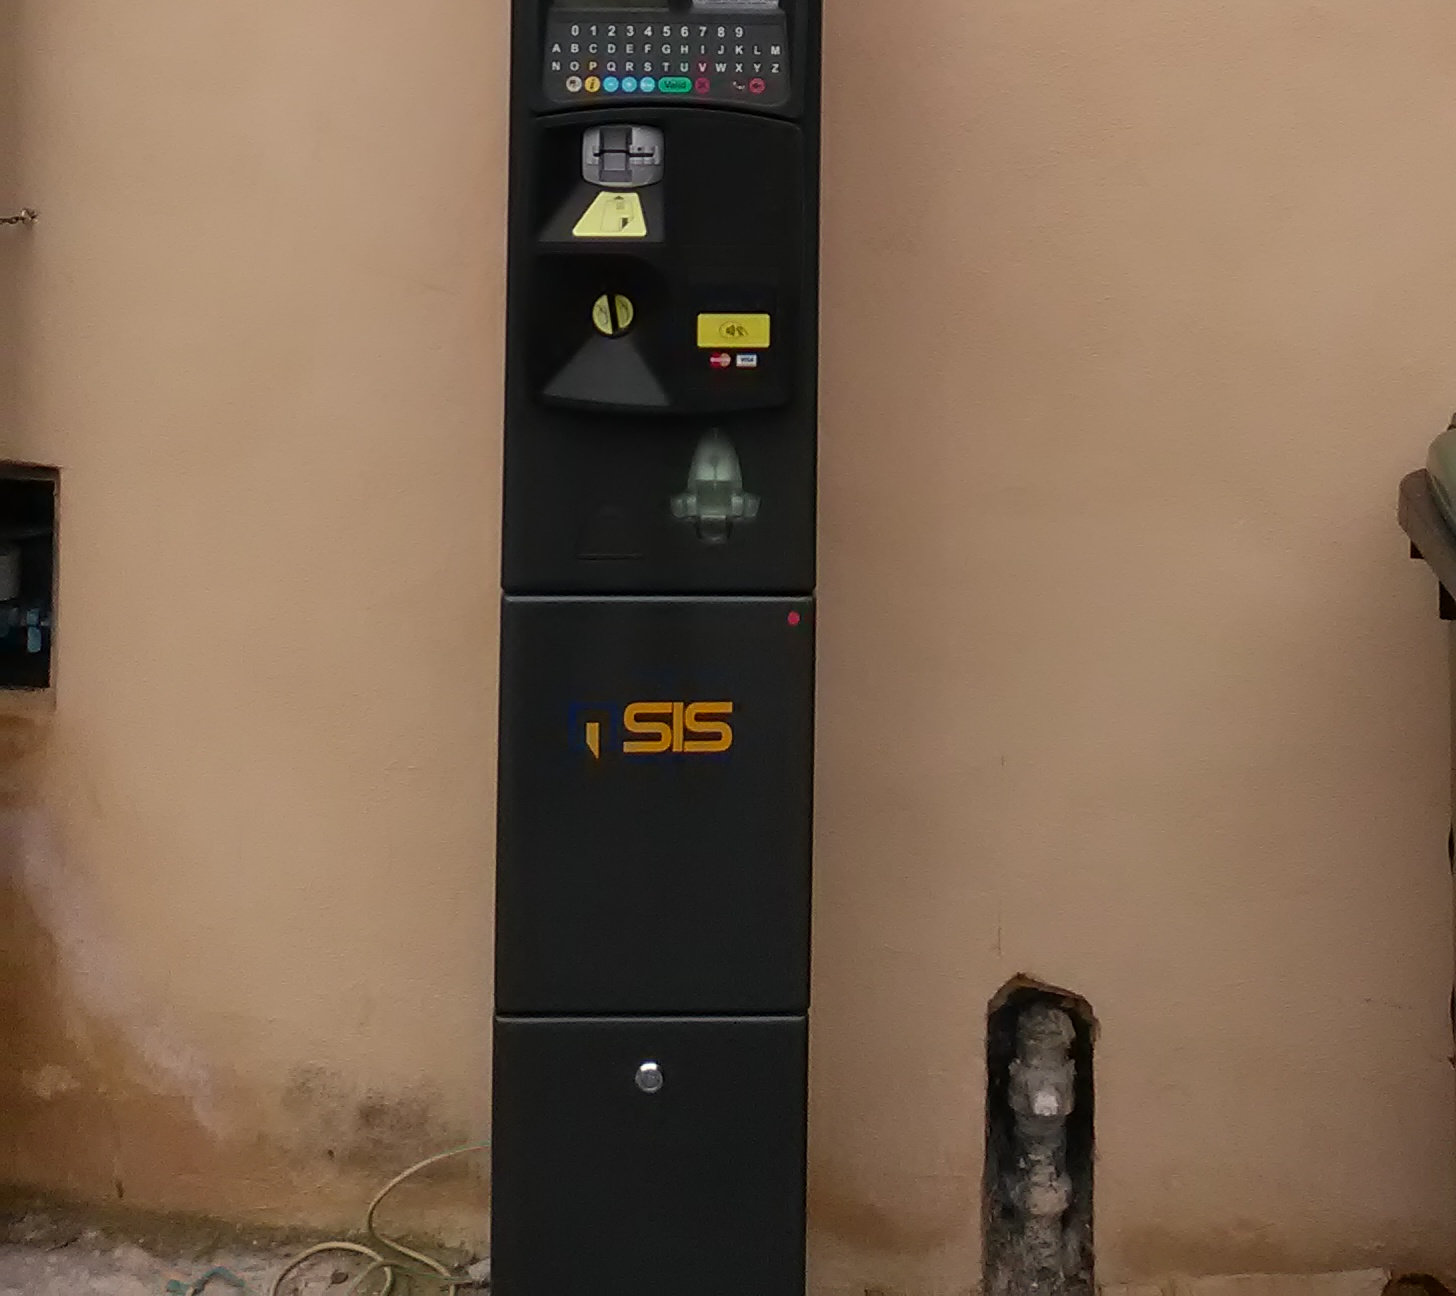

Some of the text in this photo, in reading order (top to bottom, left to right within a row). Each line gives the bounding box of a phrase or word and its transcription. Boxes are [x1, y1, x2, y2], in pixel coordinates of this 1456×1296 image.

[571, 25, 743, 38] 0 1 2 3 4 5 6 7 8 9
[552, 43, 780, 55] A B C D E F G H I J K L M
[552, 61, 779, 73] N O P Q R S T U V W X Y Z
[623, 701, 733, 753] SIS
